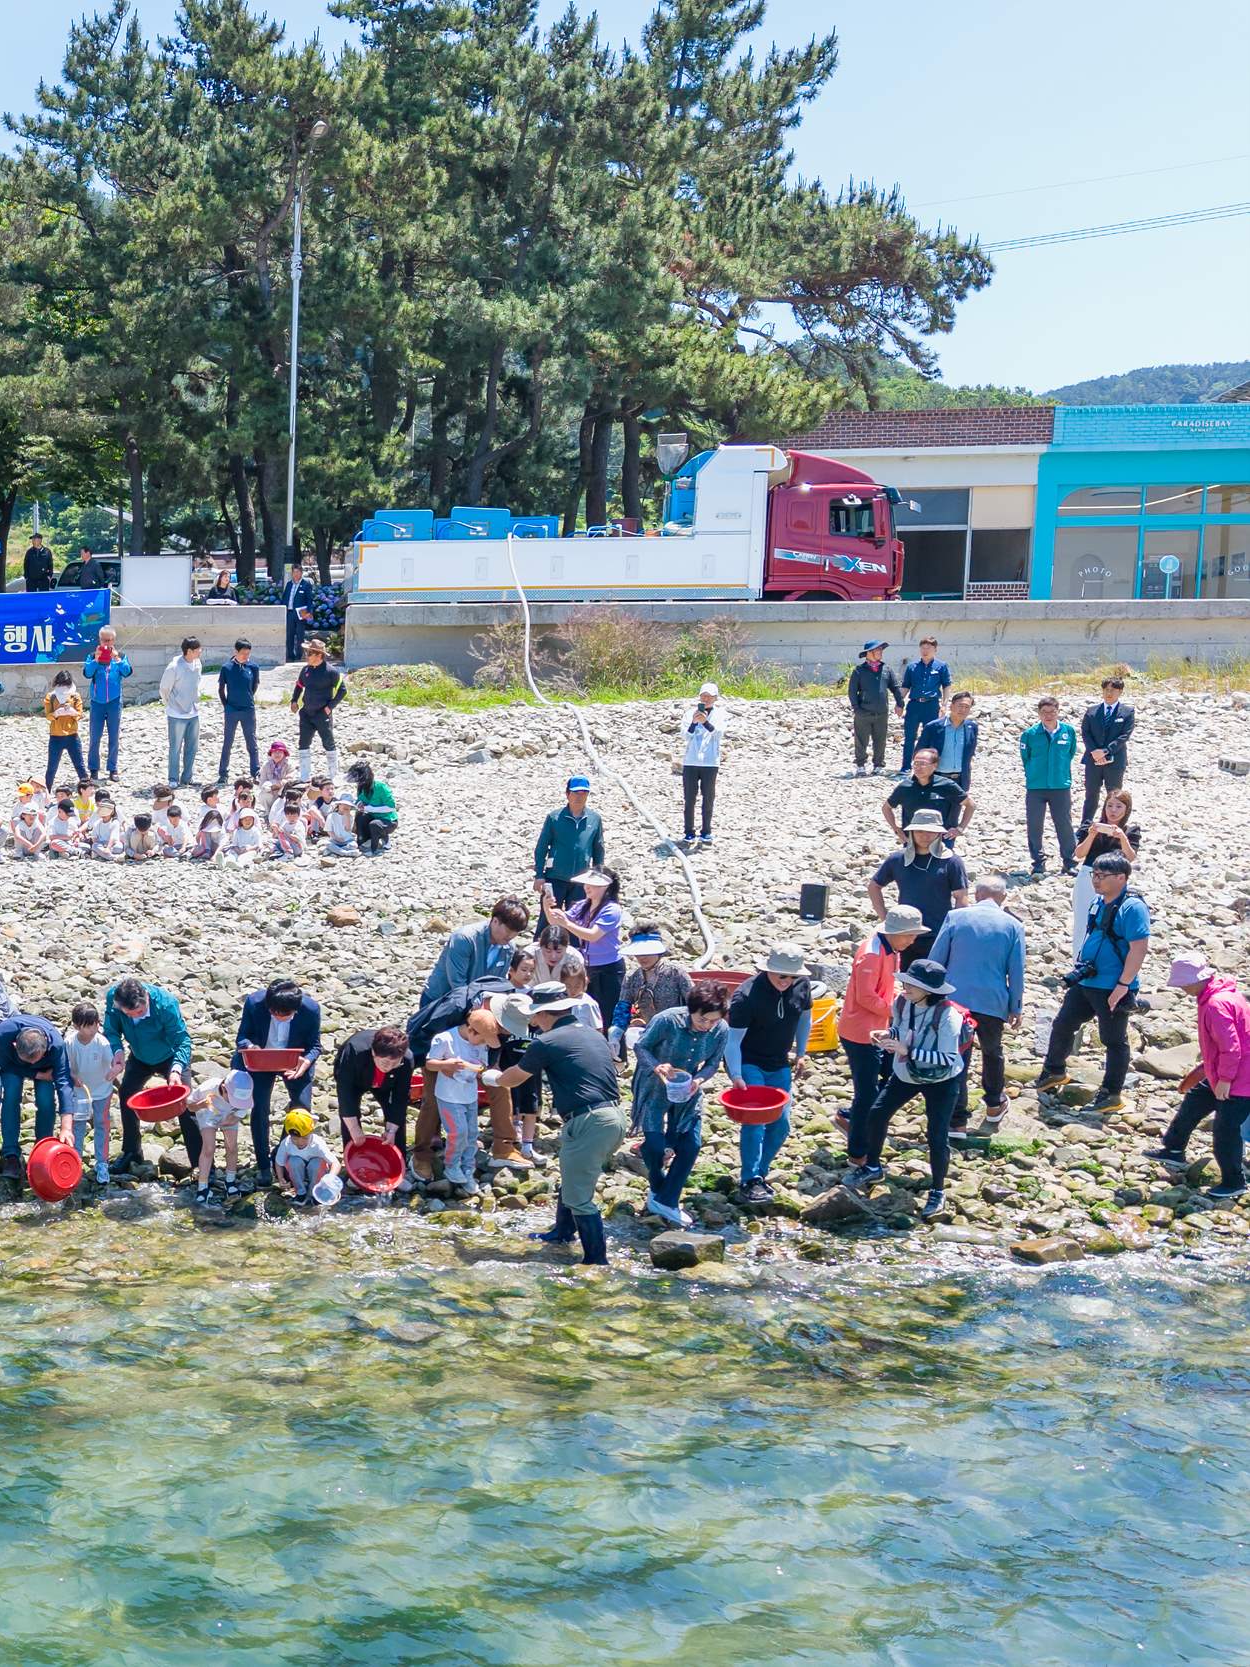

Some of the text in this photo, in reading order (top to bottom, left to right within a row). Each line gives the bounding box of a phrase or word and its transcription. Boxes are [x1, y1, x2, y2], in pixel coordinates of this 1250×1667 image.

[1171, 419, 1232, 427] PARADISEBAY
[841, 554, 888, 574] XEN
[1078, 566, 1112, 577] PHOTO
